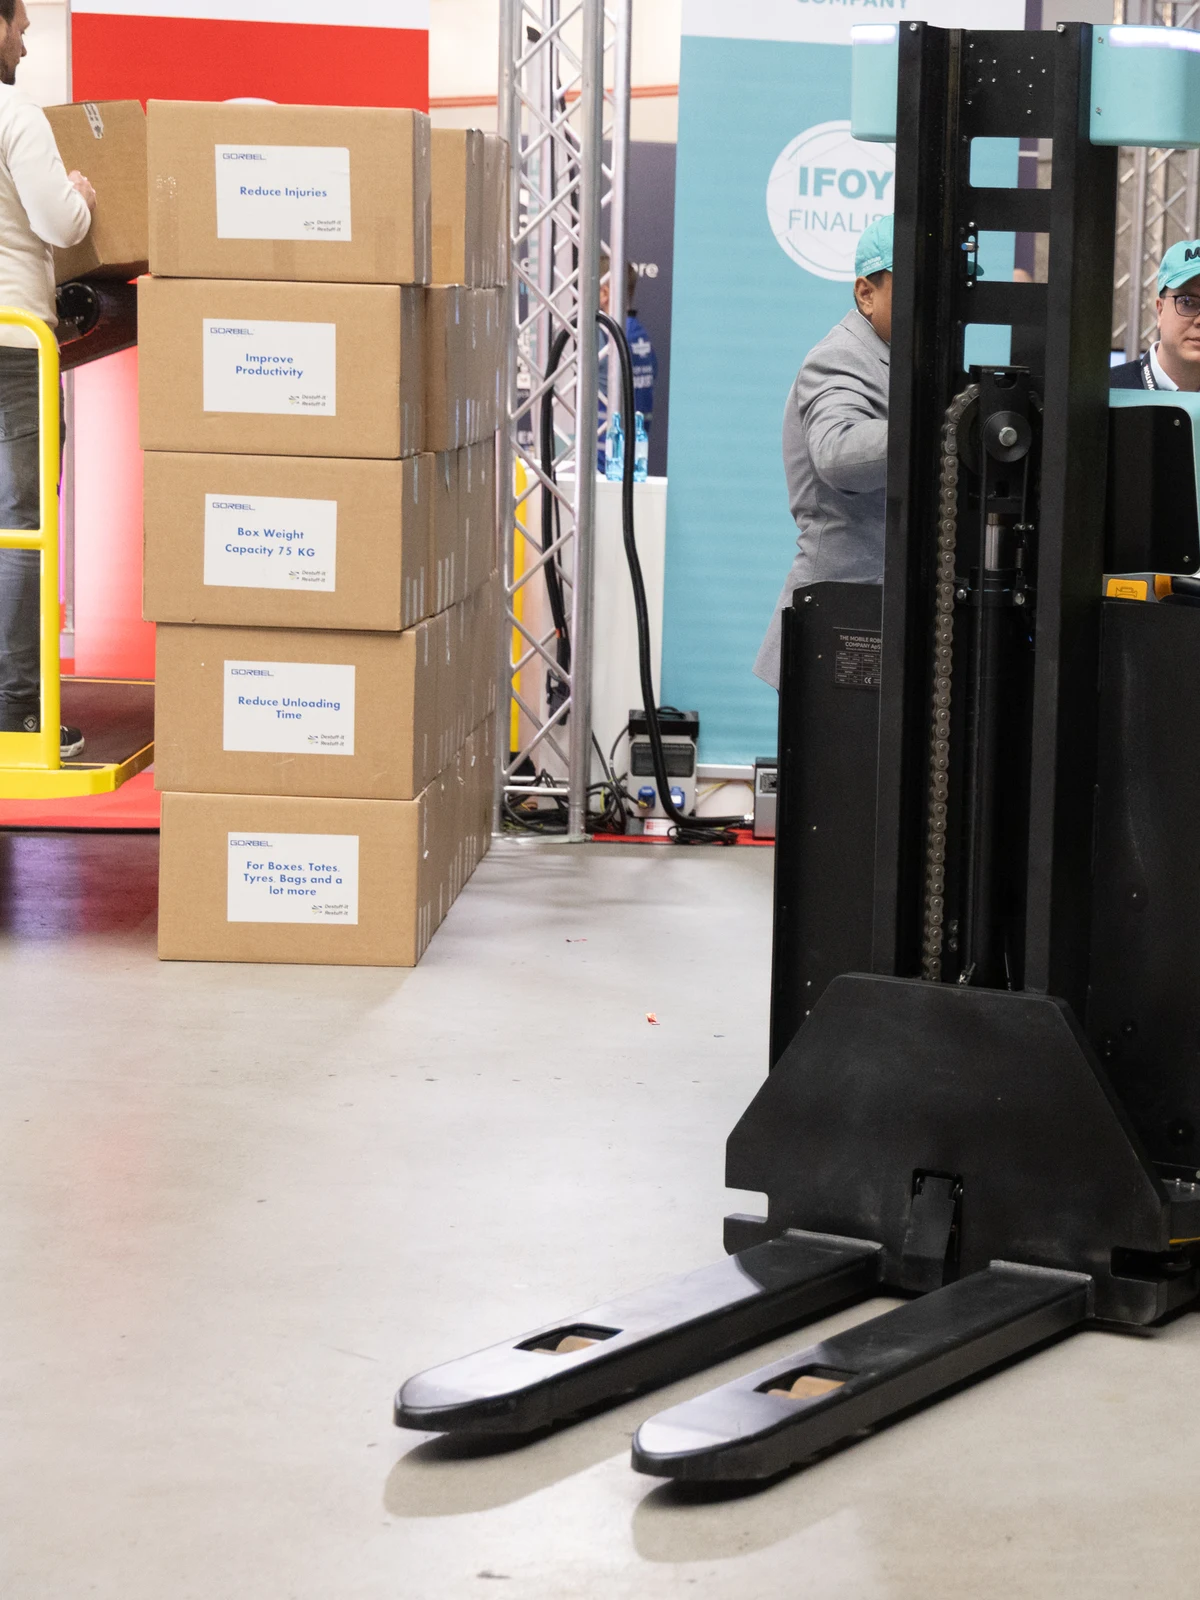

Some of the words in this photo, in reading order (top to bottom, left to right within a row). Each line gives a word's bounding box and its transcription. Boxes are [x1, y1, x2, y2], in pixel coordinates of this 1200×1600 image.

[799, 166, 894, 201] IFOY
[240, 186, 281, 197] Reduce
[285, 187, 327, 199] Injuries
[210, 327, 254, 335] GORBEL
[245, 353, 294, 365] Improve
[235, 365, 304, 379] Productivity
[212, 502, 256, 511] GORBEL
[237, 527, 260, 537] Box
[263, 529, 304, 541] Weight
[225, 544, 274, 557] Capacity
[278, 546, 292, 556] 75
[297, 548, 315, 557] KG
[231, 668, 274, 677] GORBEL
[238, 696, 279, 707] Reduce
[282, 698, 341, 711] Unloading
[276, 709, 302, 720] Time
[230, 839, 273, 847] GORBEL
[246, 860, 264, 870] For
[280, 874, 307, 886] Bags
[310, 875, 332, 884] and
[269, 885, 284, 895] lot
[287, 887, 317, 896] more
